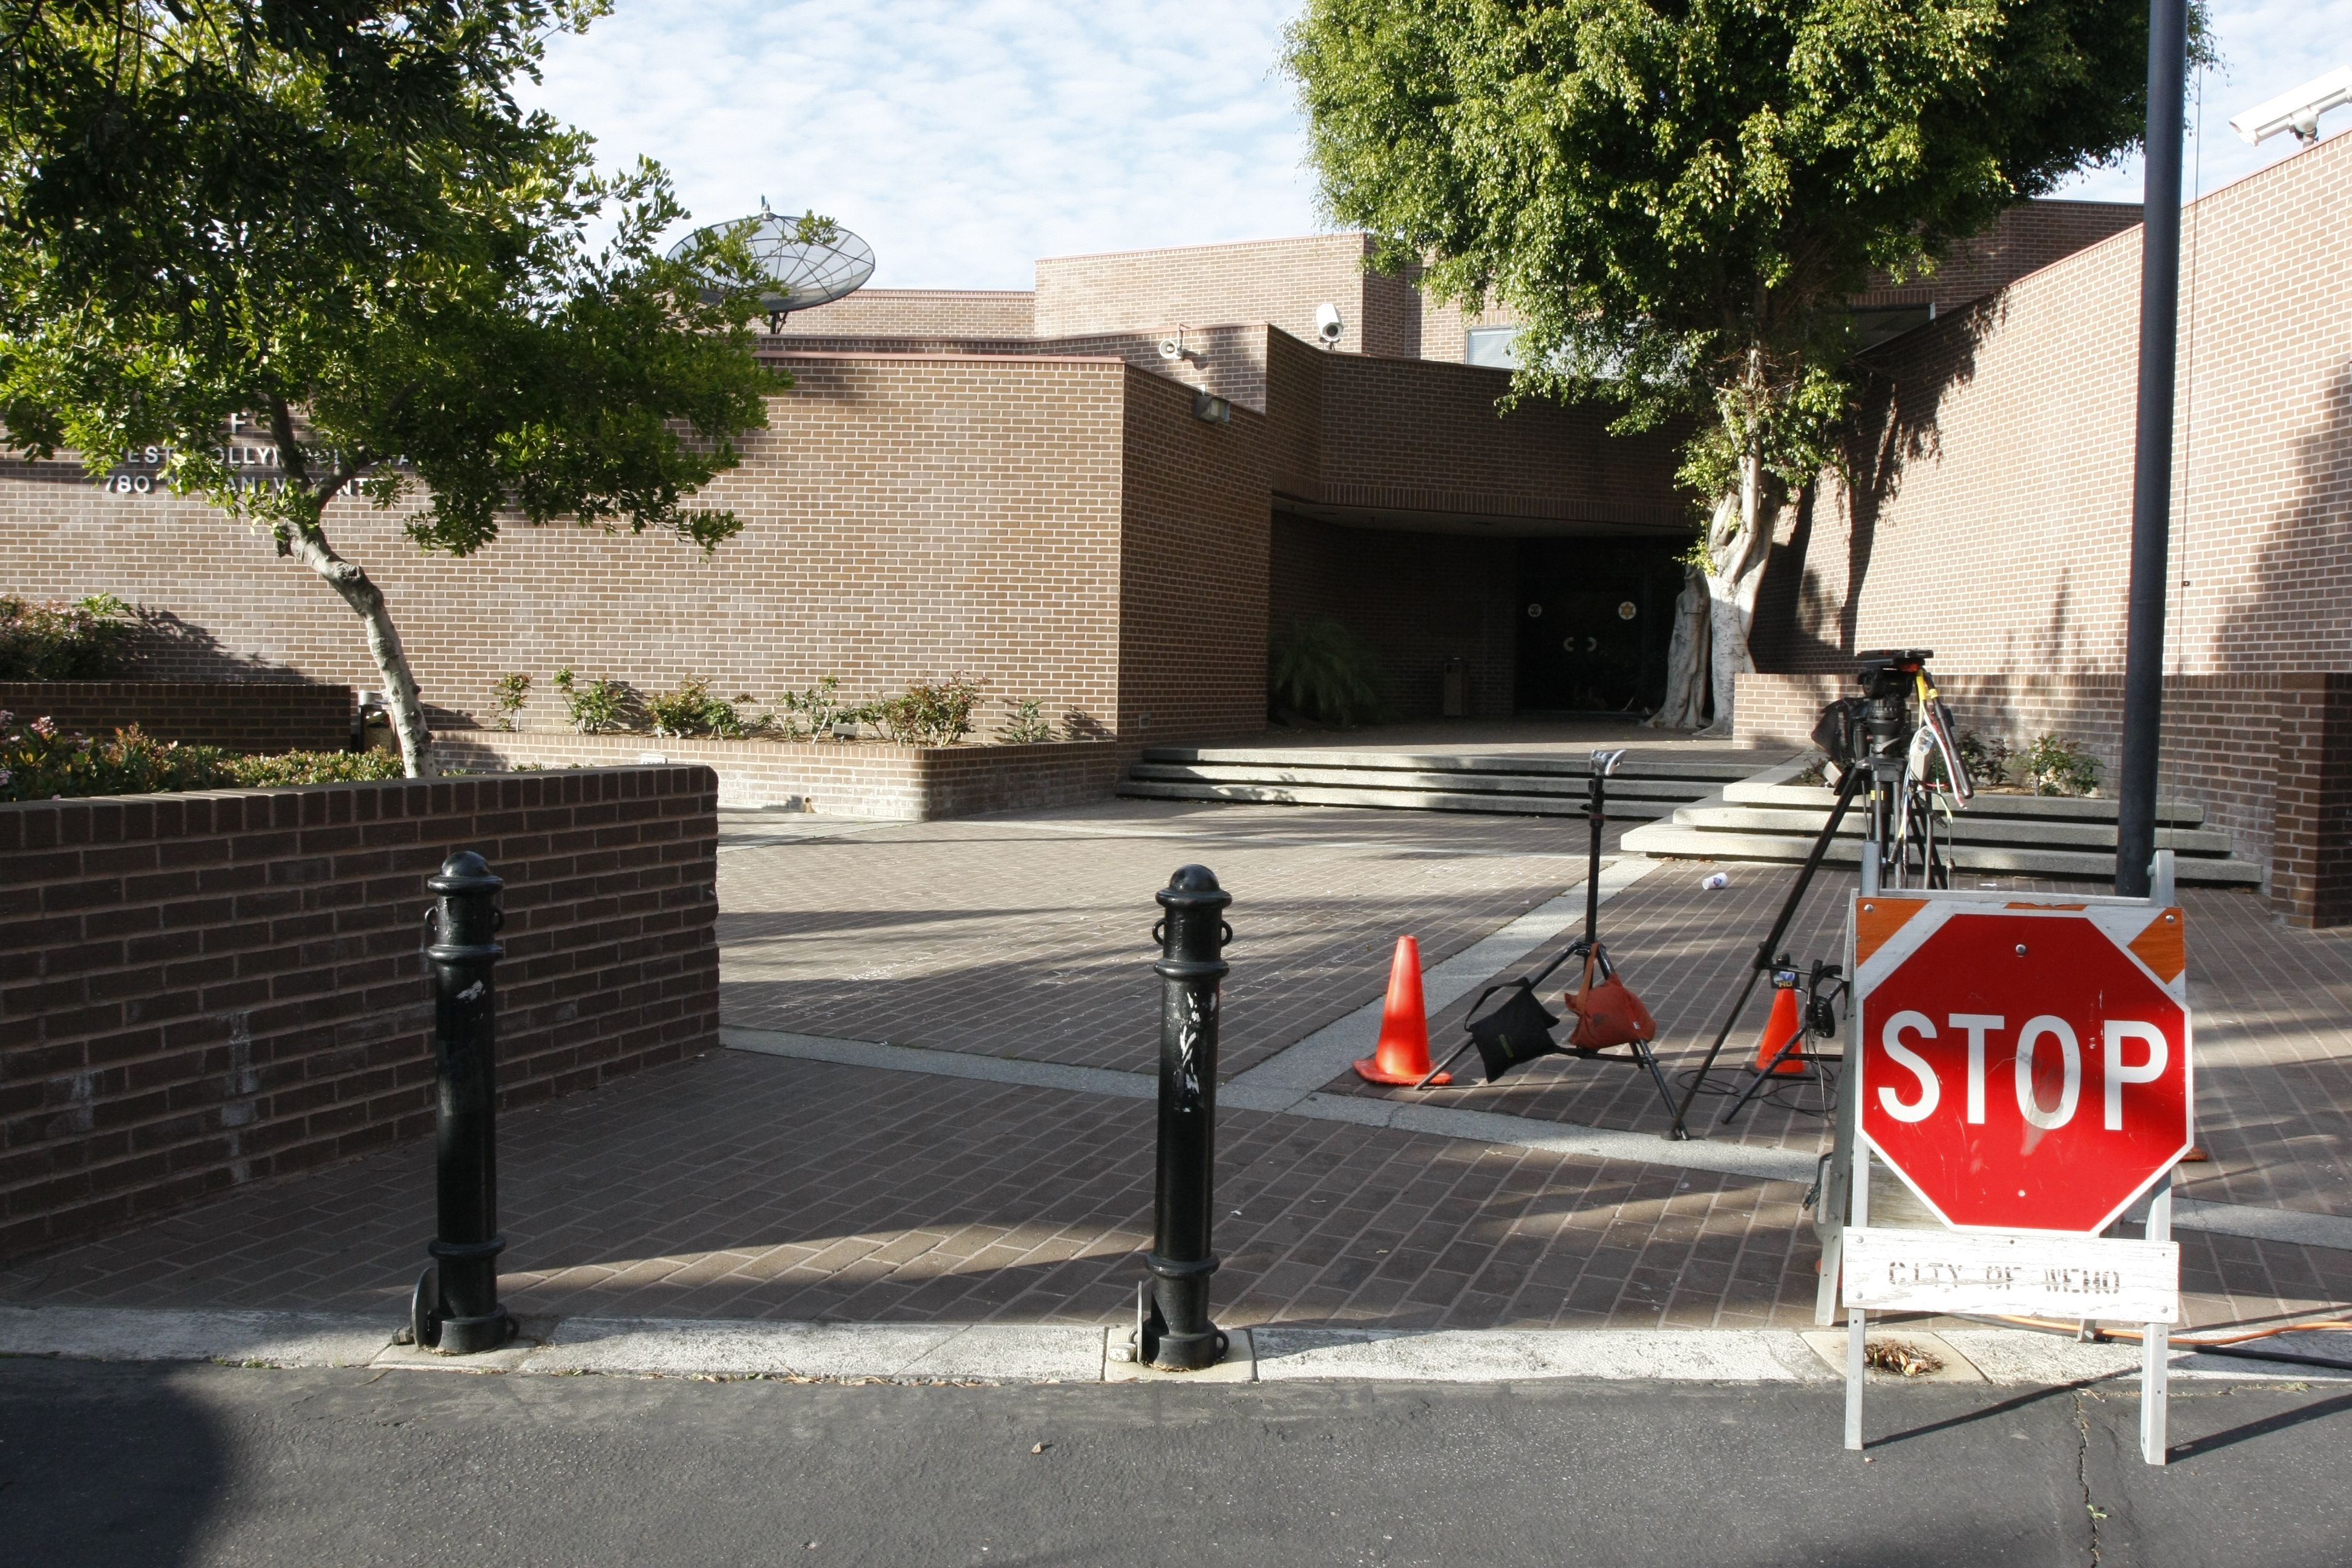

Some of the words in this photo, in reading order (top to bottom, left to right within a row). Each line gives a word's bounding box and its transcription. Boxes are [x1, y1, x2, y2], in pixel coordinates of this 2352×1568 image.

[119, 445, 174, 464] EST
[105, 475, 150, 493] 780
[1878, 1010, 2168, 1130] STOP
[1889, 1261, 1963, 1288] CITY
[1986, 1266, 2022, 1290] OF
